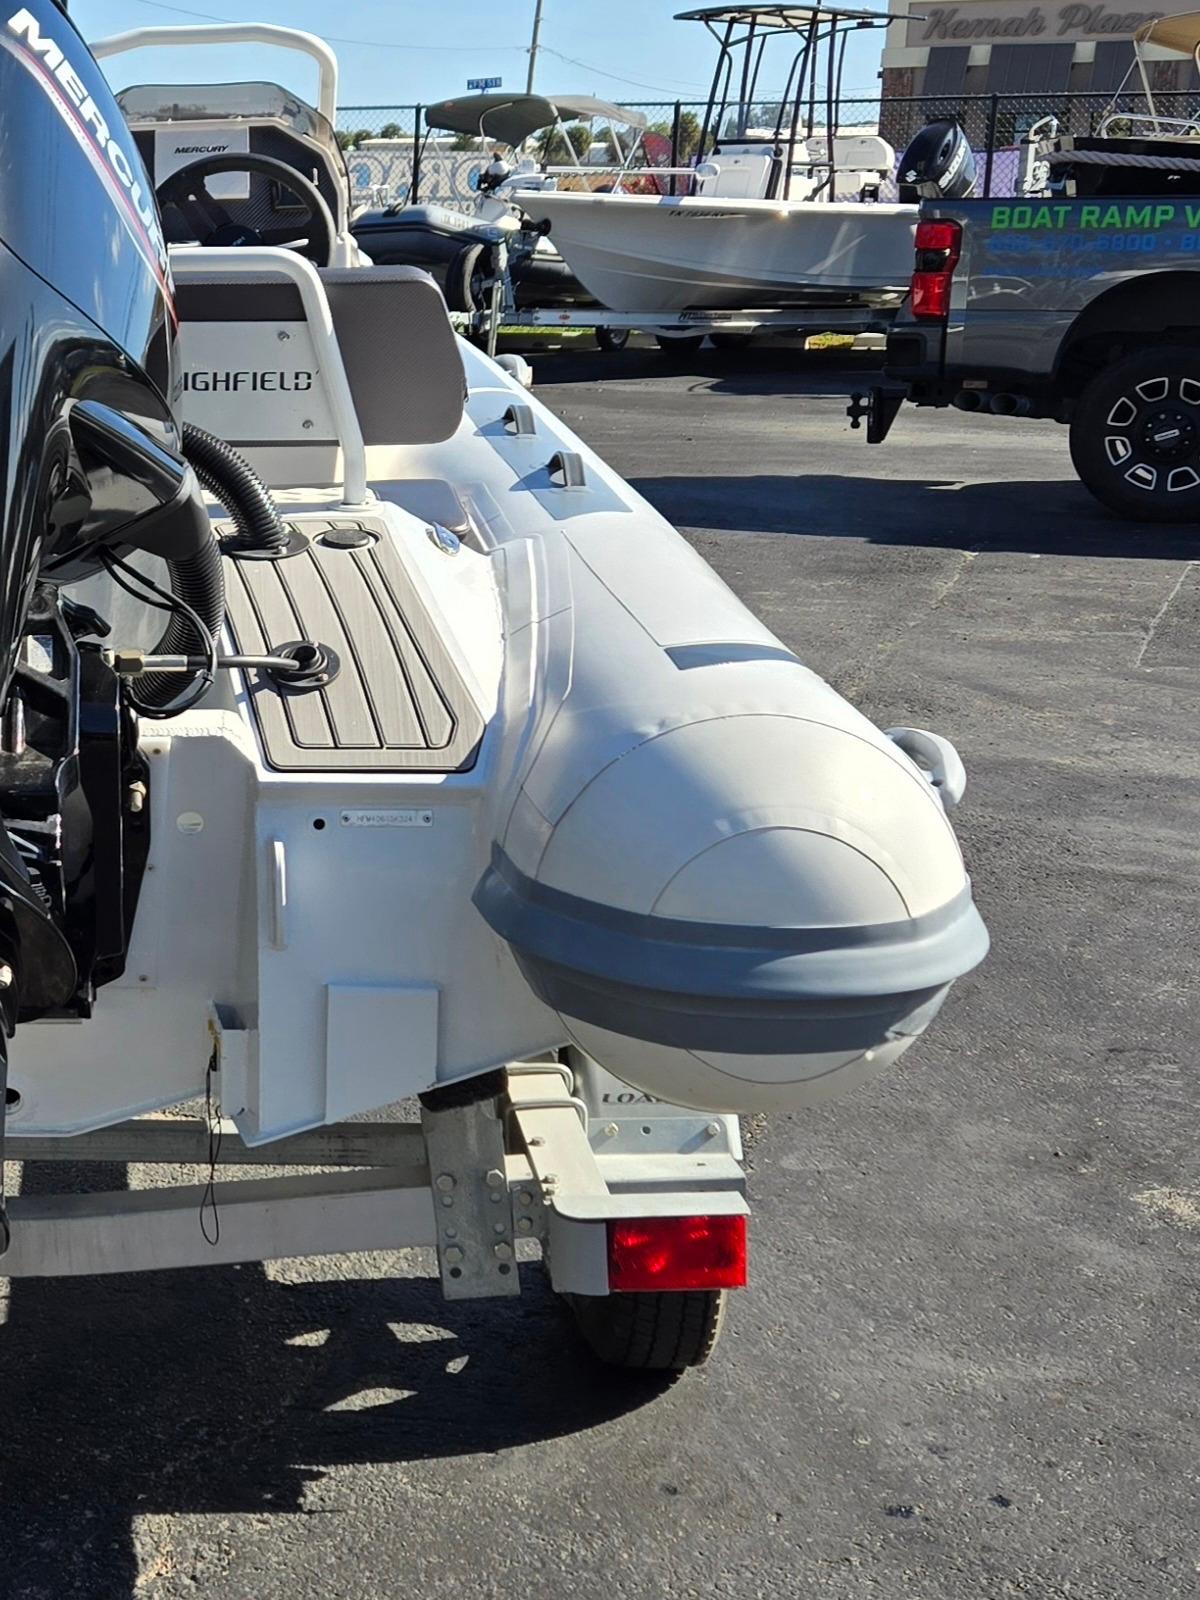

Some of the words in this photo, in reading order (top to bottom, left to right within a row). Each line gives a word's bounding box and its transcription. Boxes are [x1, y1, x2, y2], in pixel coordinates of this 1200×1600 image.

[922, 7, 1048, 41] Kemah
[174, 144, 229, 154] MERCURY
[991, 206, 1072, 229] BOAT
[1080, 205, 1175, 229] RAMP
[183, 371, 312, 391] IGHFIELD
